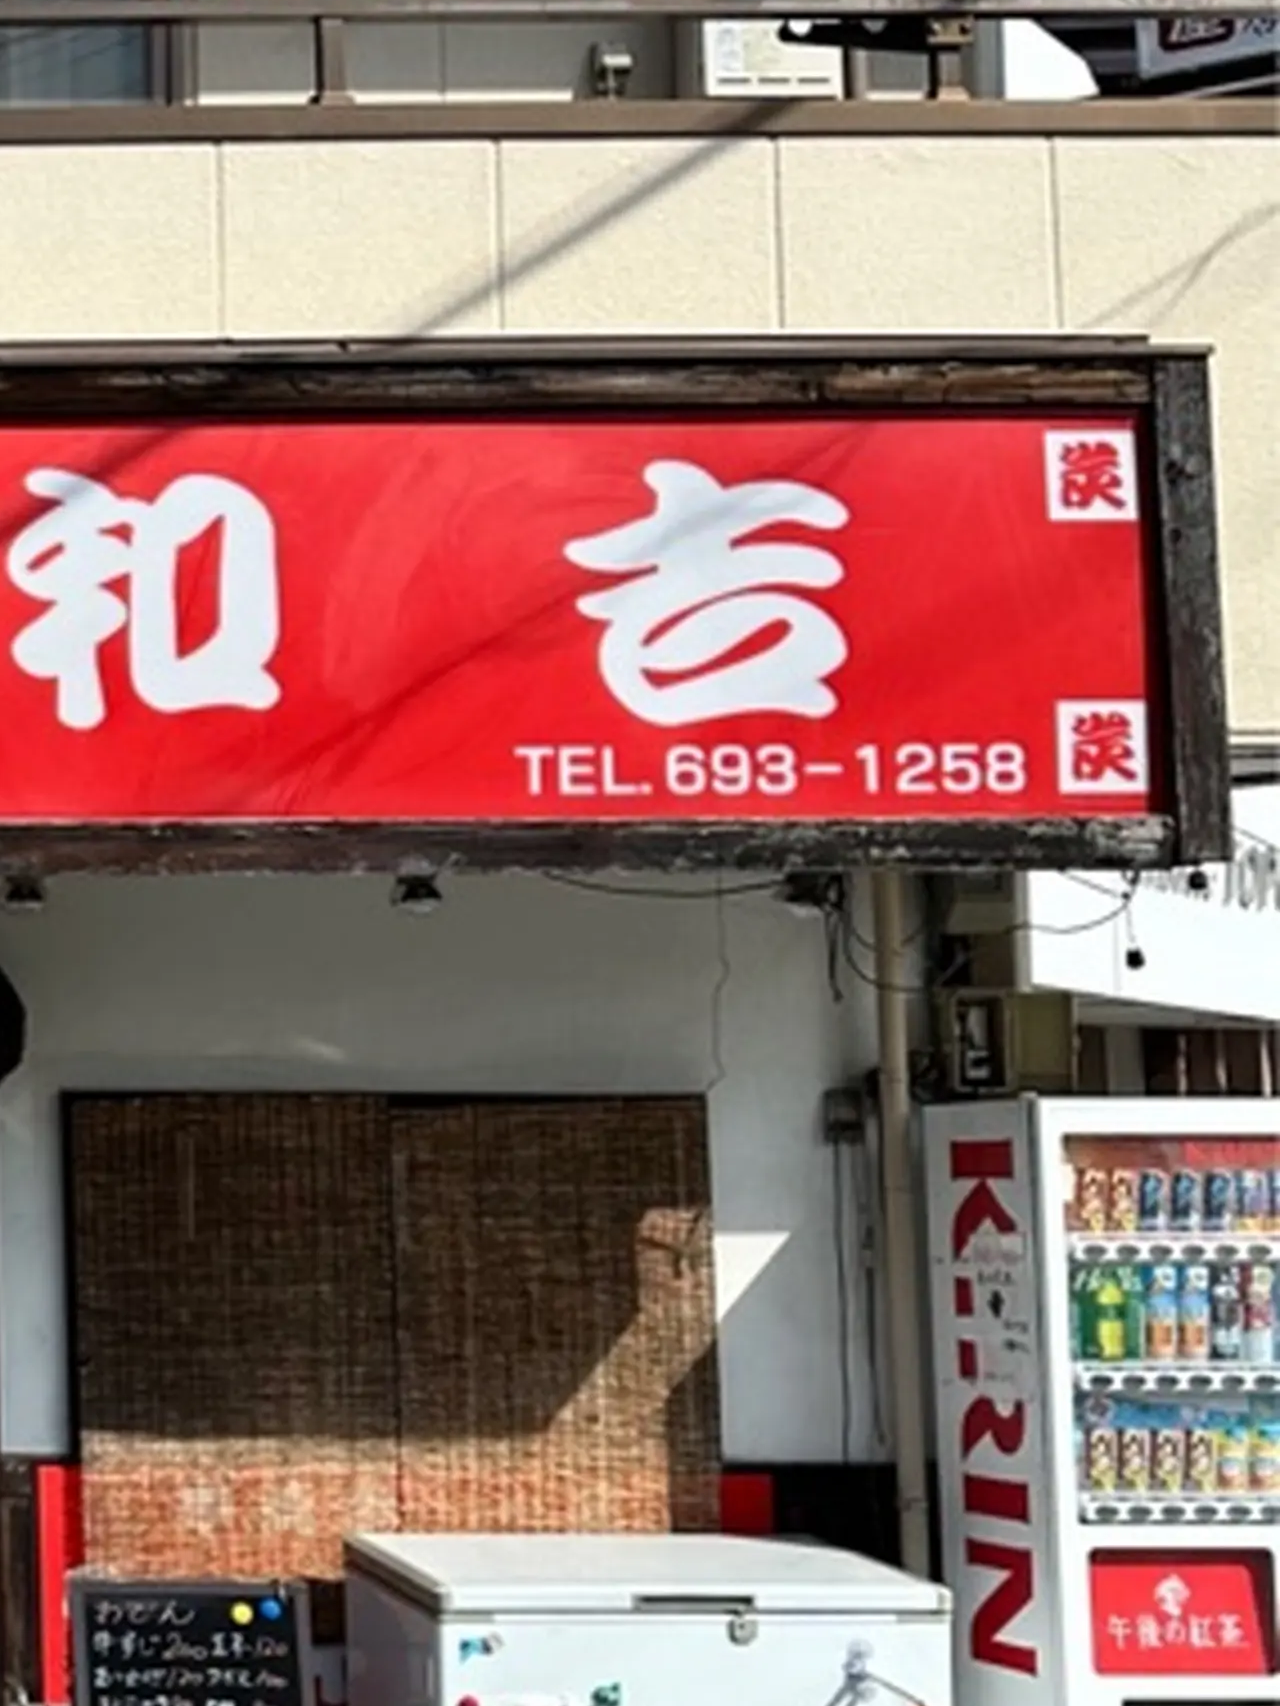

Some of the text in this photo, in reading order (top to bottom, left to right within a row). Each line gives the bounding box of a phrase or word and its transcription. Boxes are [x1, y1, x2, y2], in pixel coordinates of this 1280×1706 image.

[1106, 1612, 1250, 1649] 午後の紅茶
